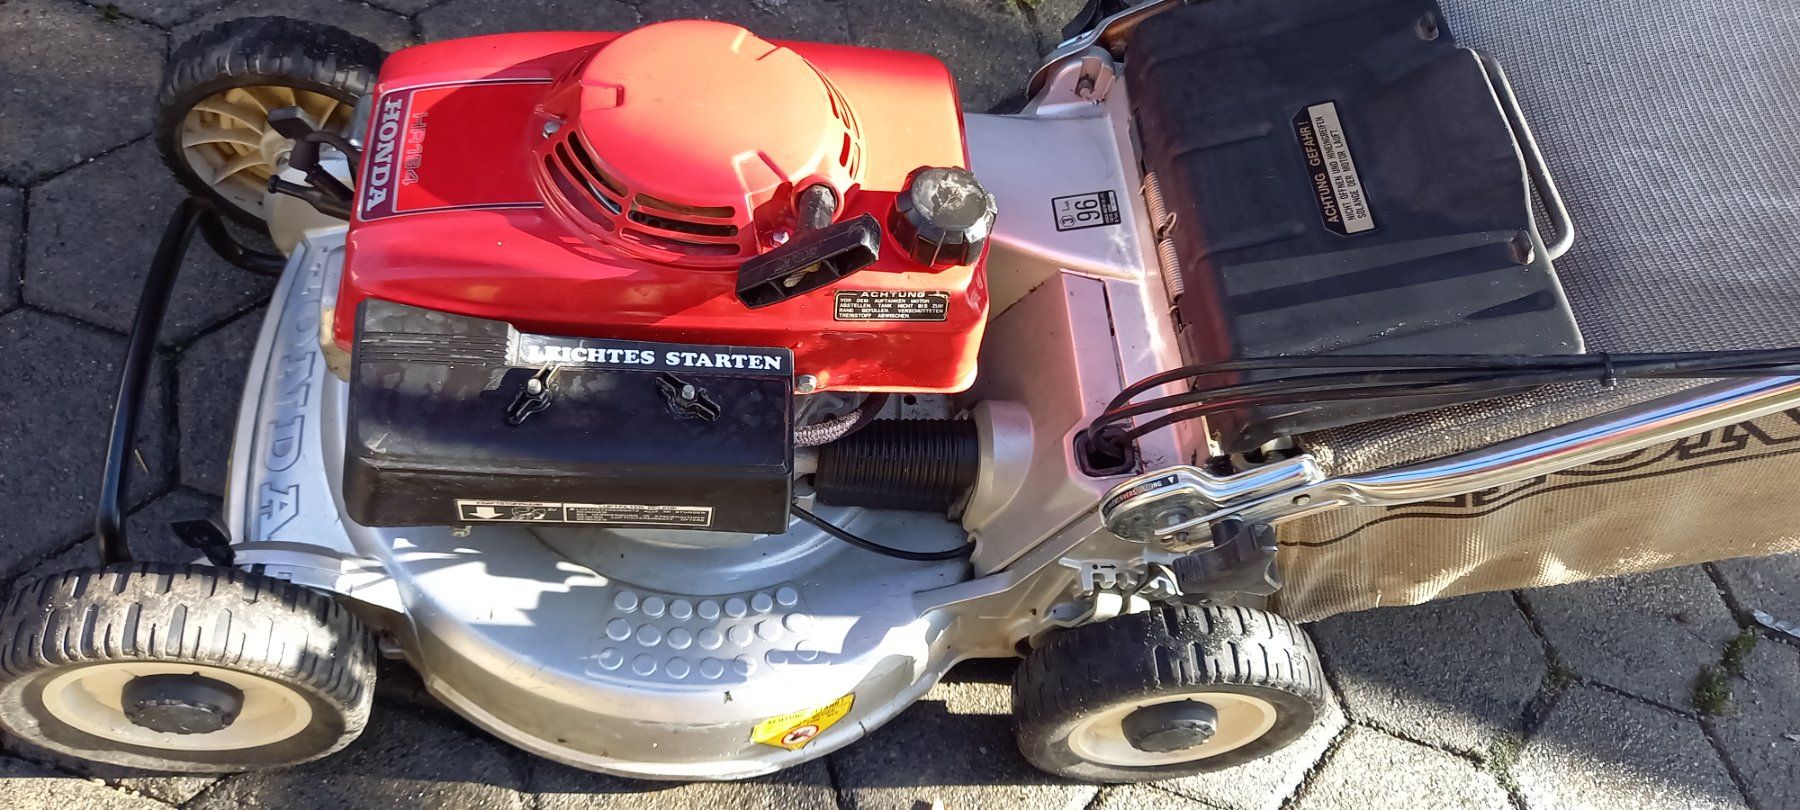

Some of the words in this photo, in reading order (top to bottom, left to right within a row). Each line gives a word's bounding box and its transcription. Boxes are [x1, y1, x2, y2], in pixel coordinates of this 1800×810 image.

[1315, 116, 1336, 160] HINEINGREIFEN
[366, 97, 402, 212] HONDA
[1337, 150, 1352, 173] MOTOR
[1329, 161, 1341, 175] UND
[1345, 174, 1357, 188] DER
[1074, 199, 1101, 222] 96
[1314, 173, 1340, 223] ACHTUNG
[1349, 189, 1367, 219] SOLANGE
[1342, 201, 1356, 221] NICHT
[527, 344, 656, 366] LEICHTES
[664, 351, 783, 371] STARTEN
